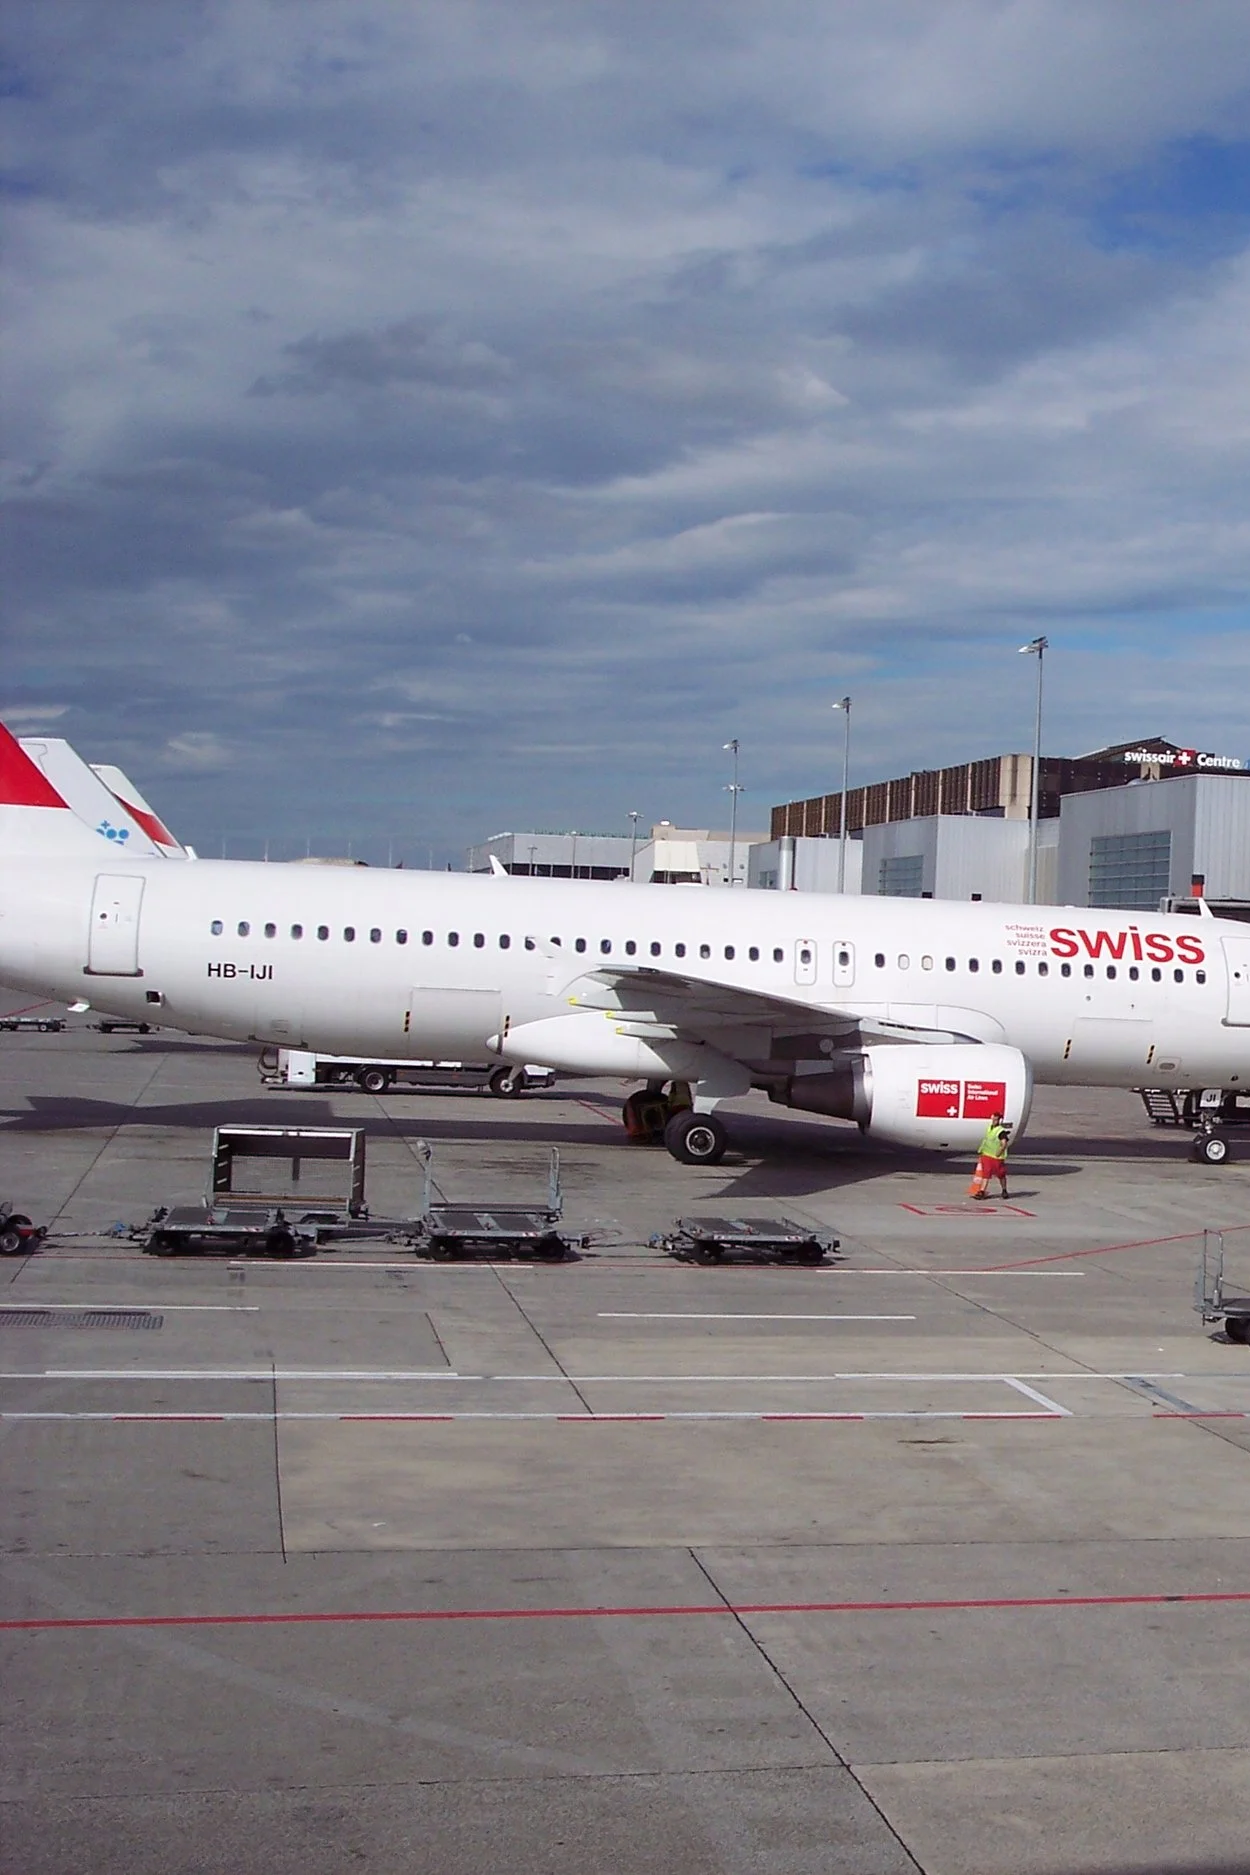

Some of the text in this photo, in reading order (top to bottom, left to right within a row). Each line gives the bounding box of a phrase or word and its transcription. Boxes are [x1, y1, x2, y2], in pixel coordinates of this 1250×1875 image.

[1124, 749, 1241, 768] swissair Centre
[1005, 924, 1044, 932] schweiz
[1006, 939, 1047, 948] svizzera
[1050, 926, 1205, 964] swiss
[1018, 948, 1048, 956] svizra
[207, 962, 273, 980] HB-IJI
[920, 1081, 958, 1095] swiss
[1206, 1094, 1216, 1102] JI
